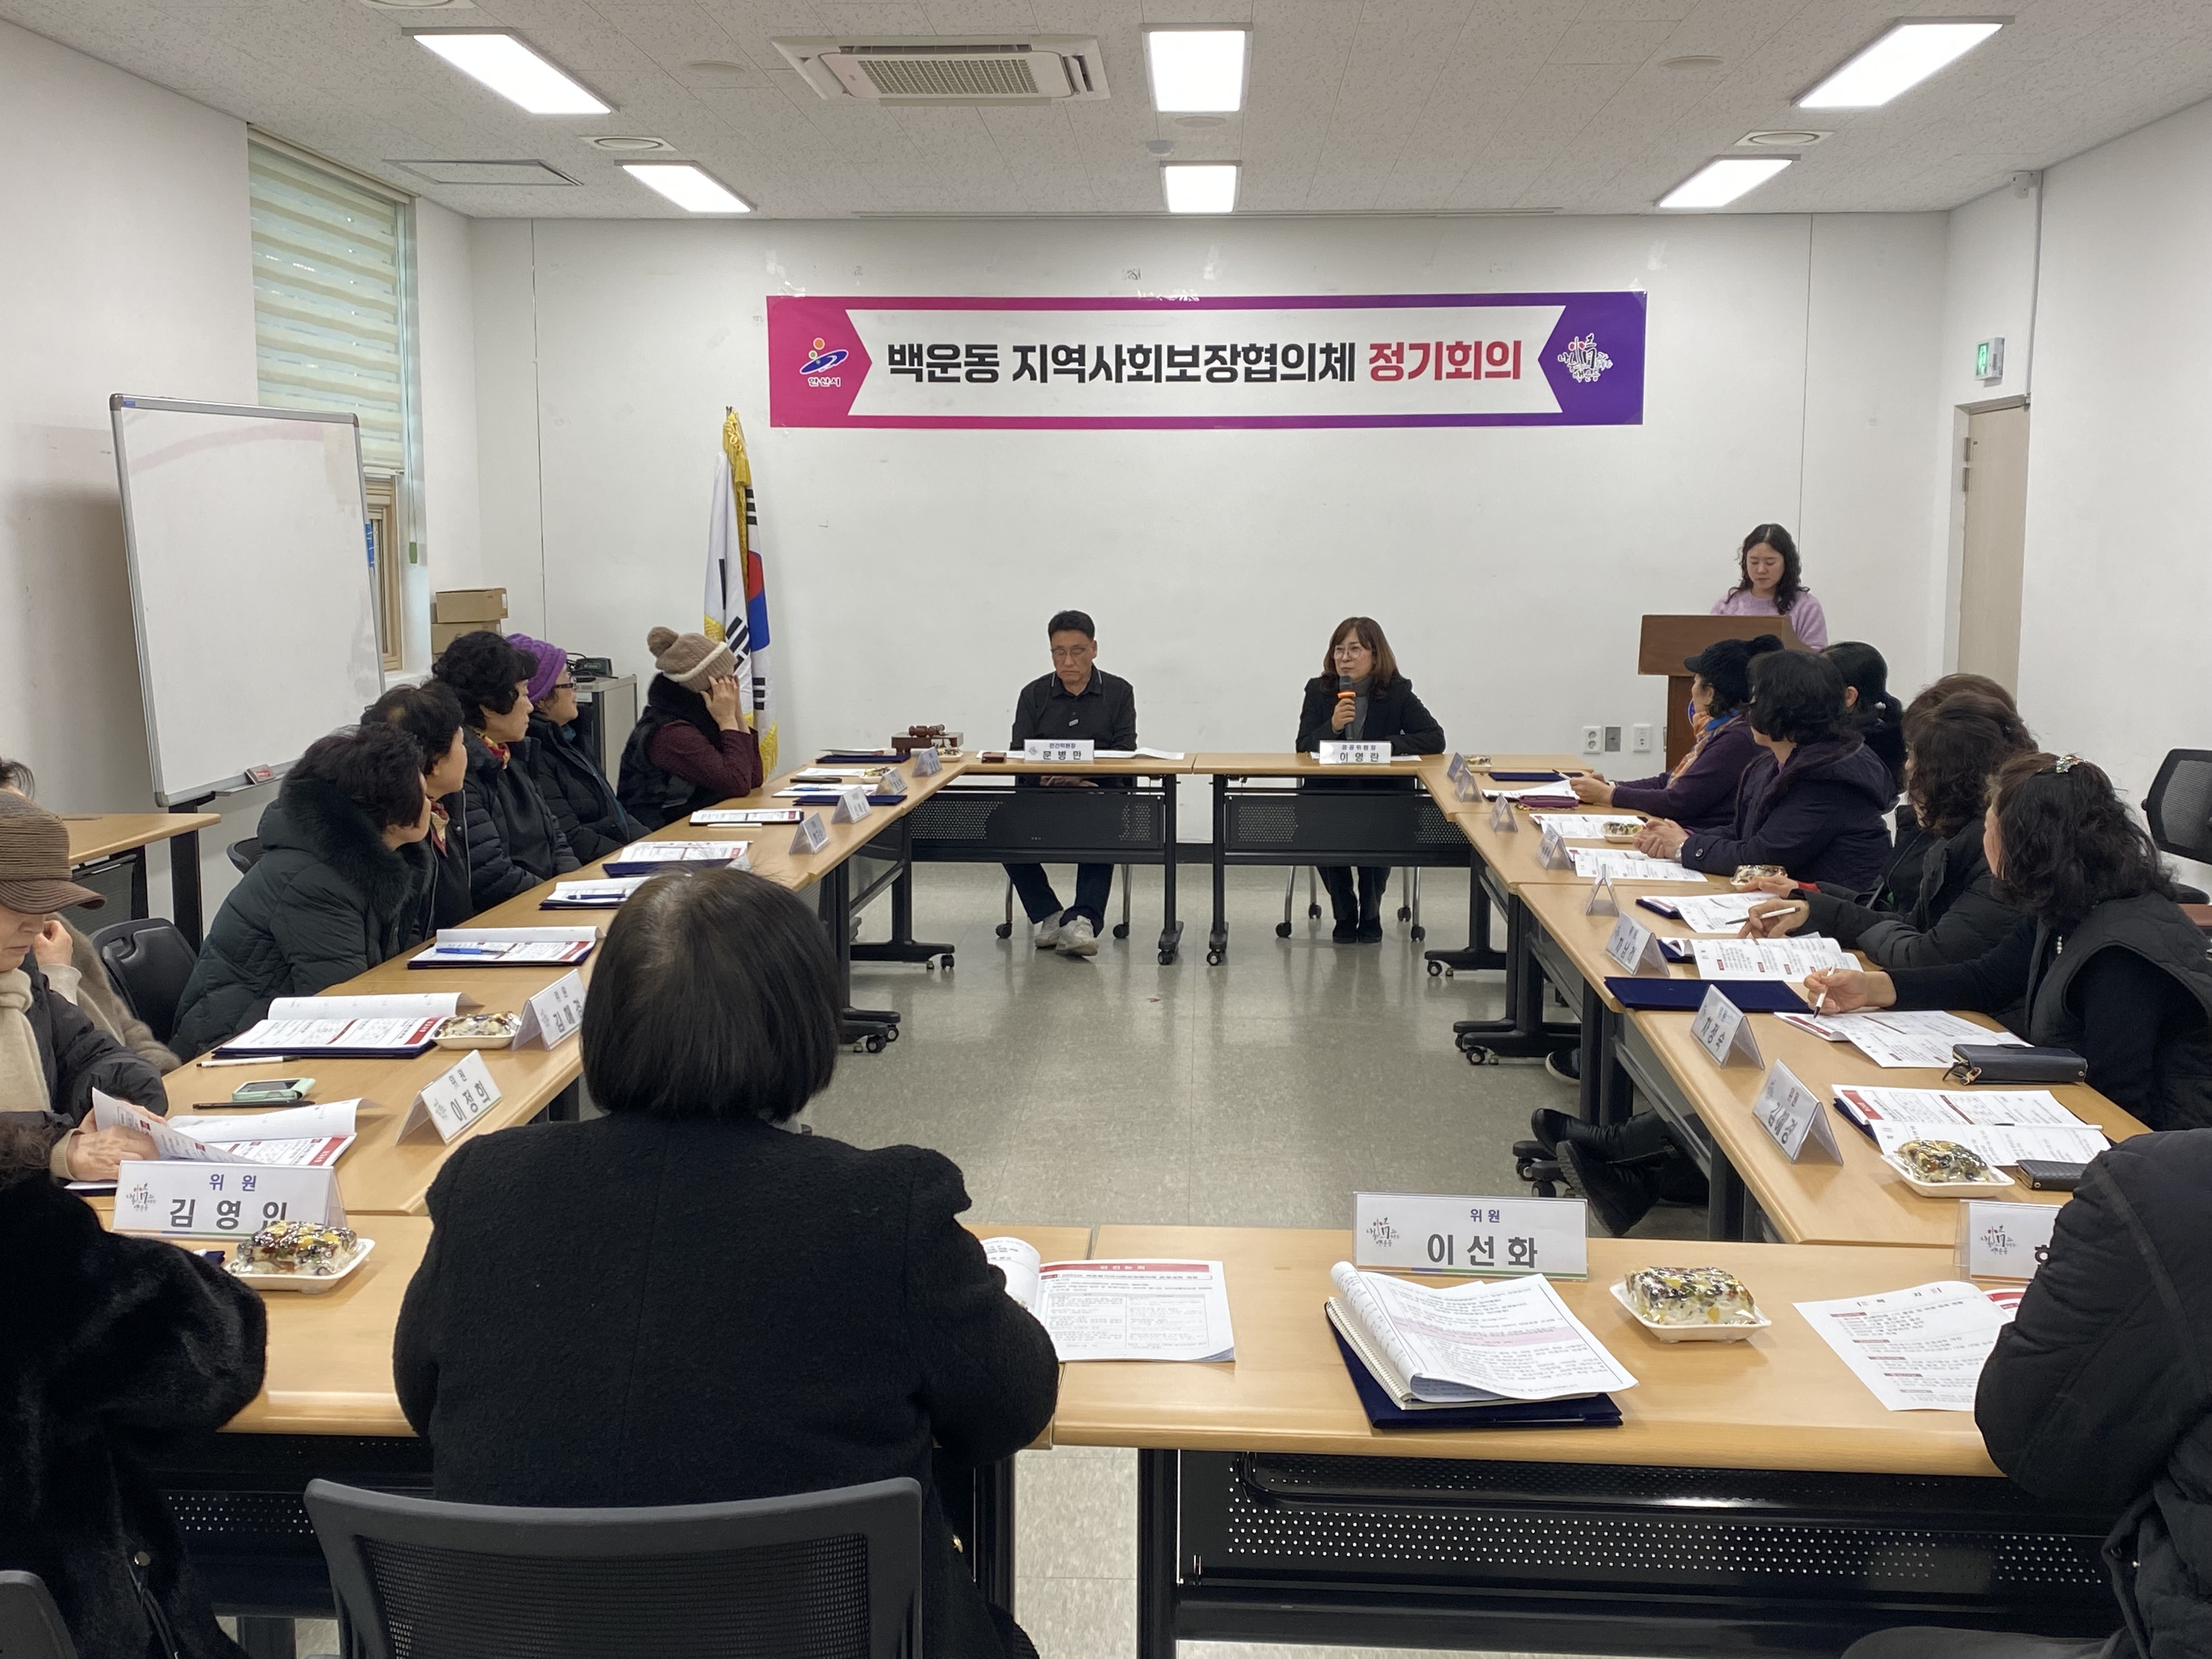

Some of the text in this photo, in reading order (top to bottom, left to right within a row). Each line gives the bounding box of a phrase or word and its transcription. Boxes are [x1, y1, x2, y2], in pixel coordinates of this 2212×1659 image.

[888, 343, 1000, 383] 백운동
[1012, 342, 1356, 383] 지역사회보장협의체
[1369, 340, 1522, 381] 정기회의
[808, 377, 841, 387] 안산시
[1340, 752, 1379, 763] 이영란
[450, 1080, 491, 1121] 이정희
[209, 1173, 257, 1192] 위원
[1470, 1209, 1500, 1223] 위원
[1427, 1233, 1538, 1268] 이선화
